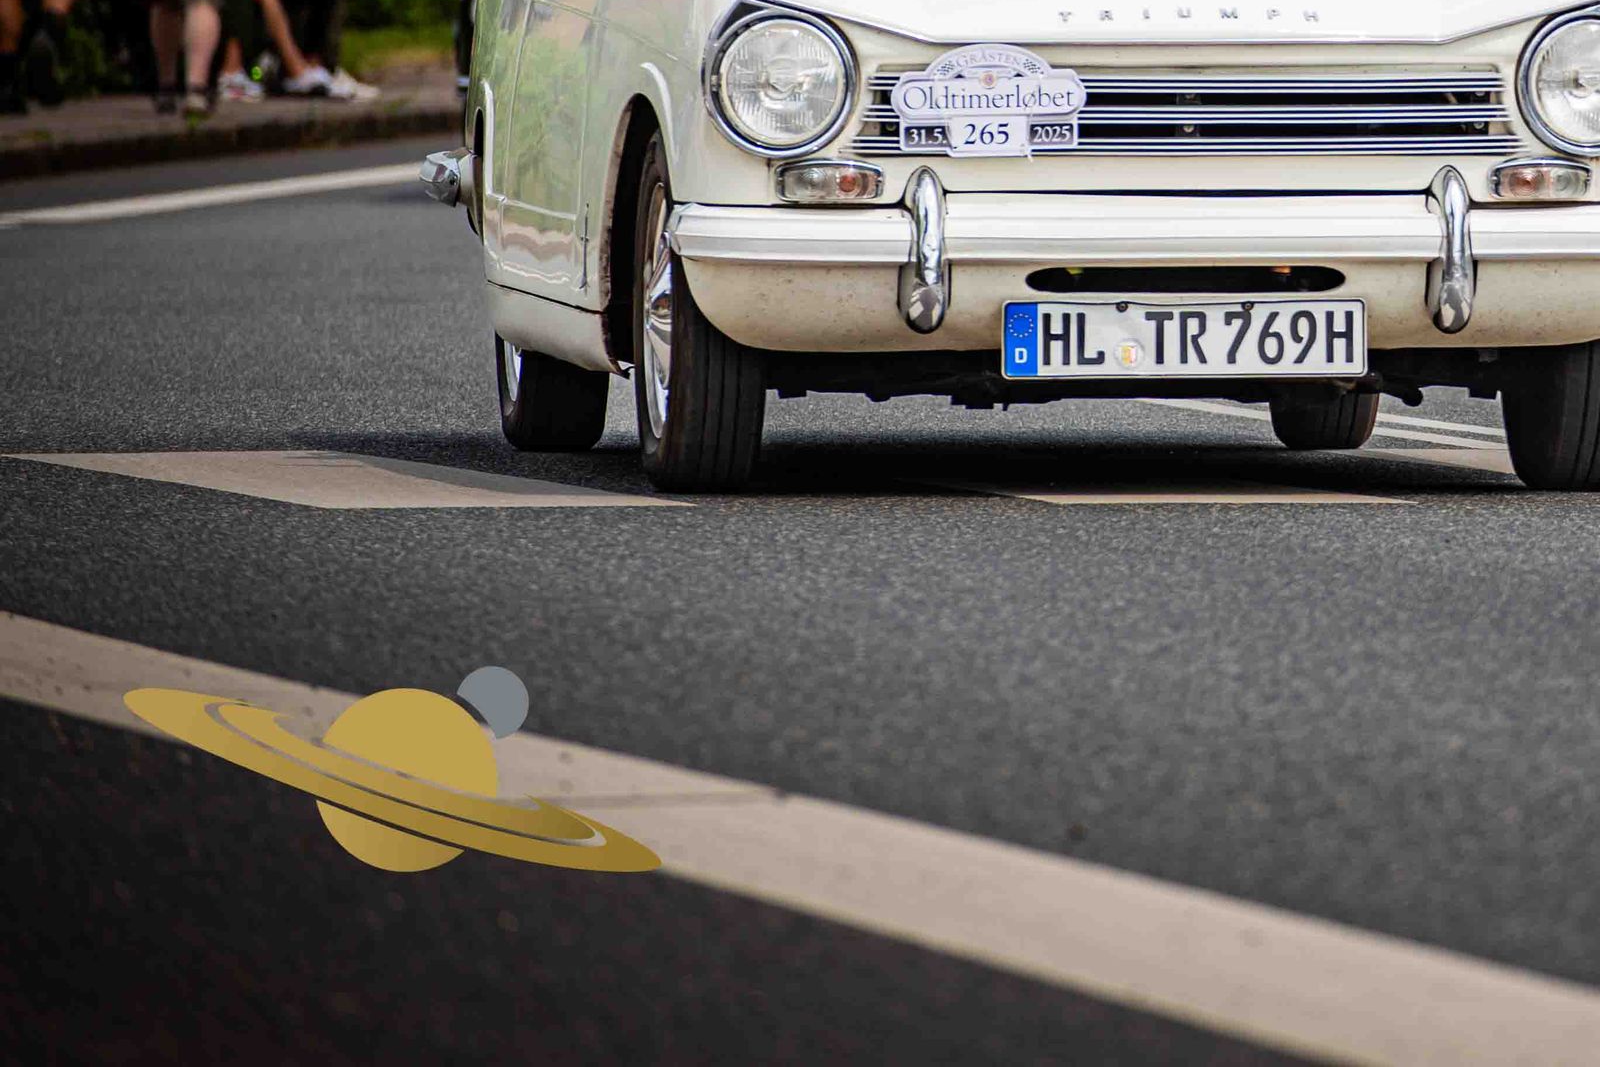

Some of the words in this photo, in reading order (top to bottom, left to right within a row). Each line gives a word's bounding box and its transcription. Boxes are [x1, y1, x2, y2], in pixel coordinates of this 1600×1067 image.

[1058, 7, 1320, 23] TRIUMPH
[903, 84, 1075, 111] Oldtimerløbet
[908, 128, 947, 145] 31.5.
[963, 123, 1010, 145] 265
[1032, 125, 1072, 143] 2025
[1042, 312, 1105, 366] HL
[1014, 347, 1028, 364] D
